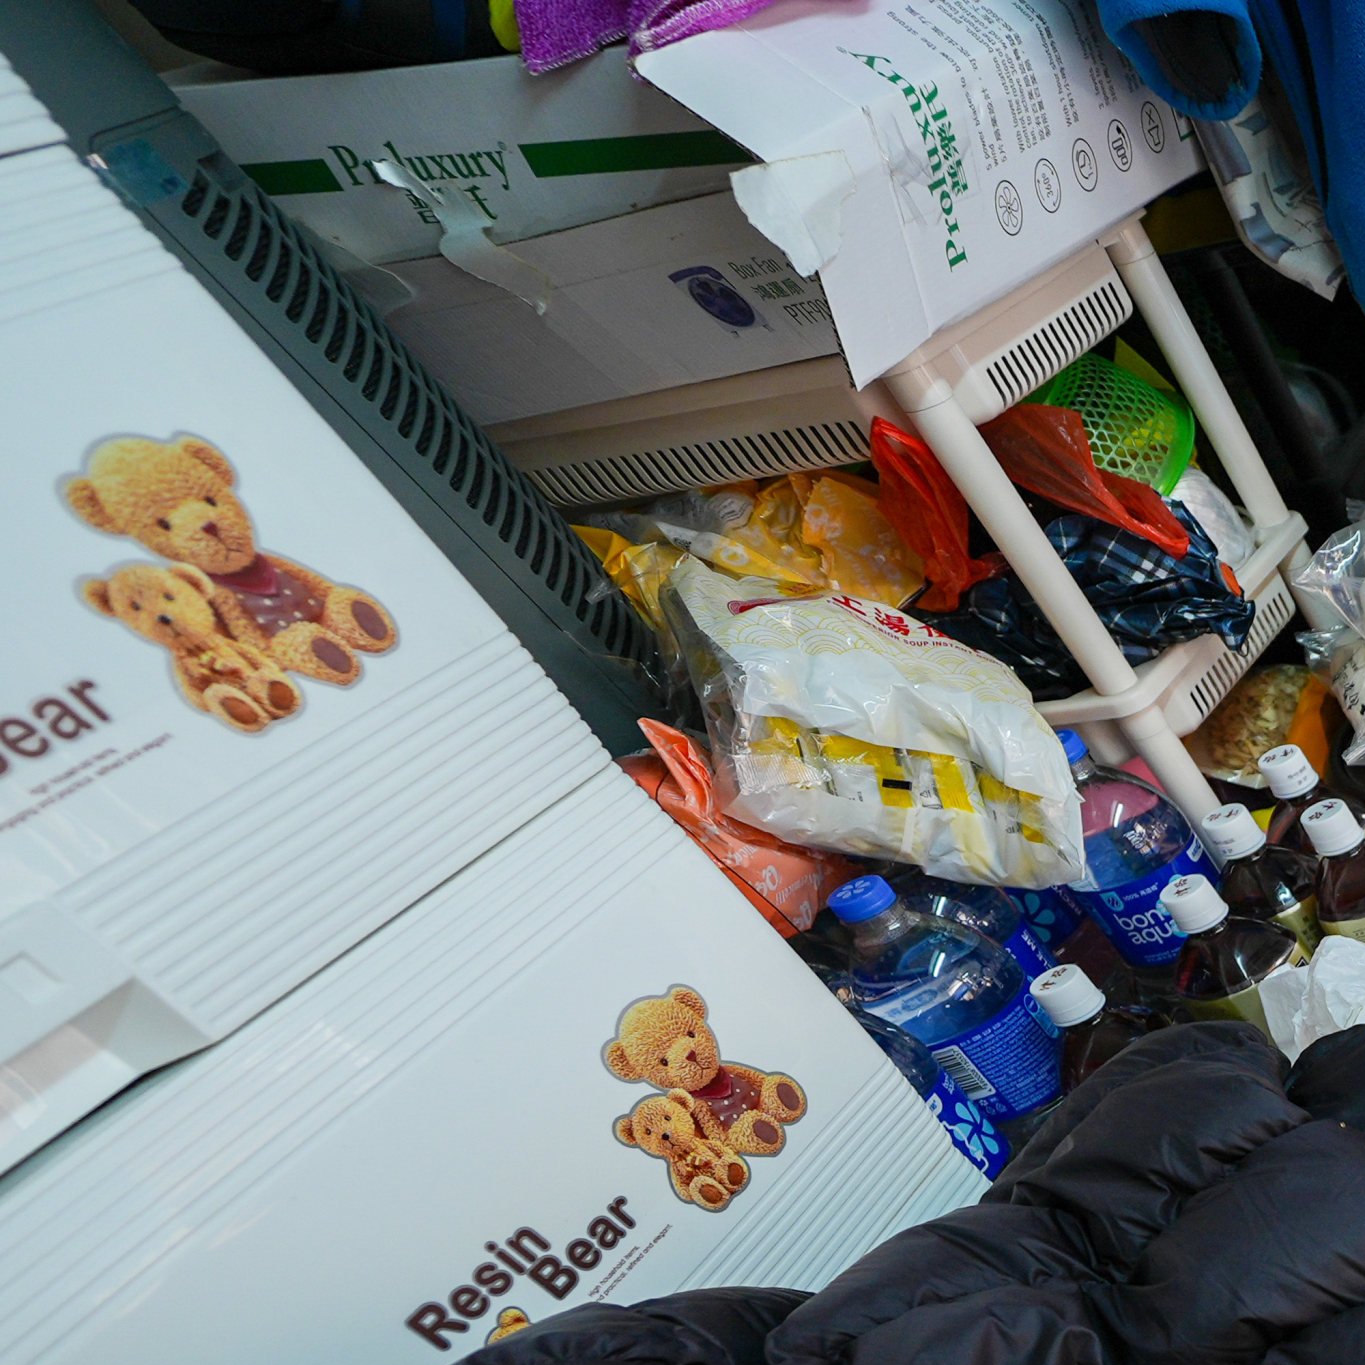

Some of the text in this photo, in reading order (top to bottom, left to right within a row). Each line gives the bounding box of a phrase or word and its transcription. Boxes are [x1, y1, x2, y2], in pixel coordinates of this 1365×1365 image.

[328, 141, 509, 190] Prluxury
[848, 49, 968, 273] Proluxury
[728, 256, 783, 280] Box Fan
[903, 639, 929, 647] SOUP
[932, 641, 973, 654] INSTANT
[0, 679, 111, 779] ear
[527, 1195, 637, 1300] Bear
[643, 1242, 654, 1254] and
[404, 1226, 551, 1352] Resin
